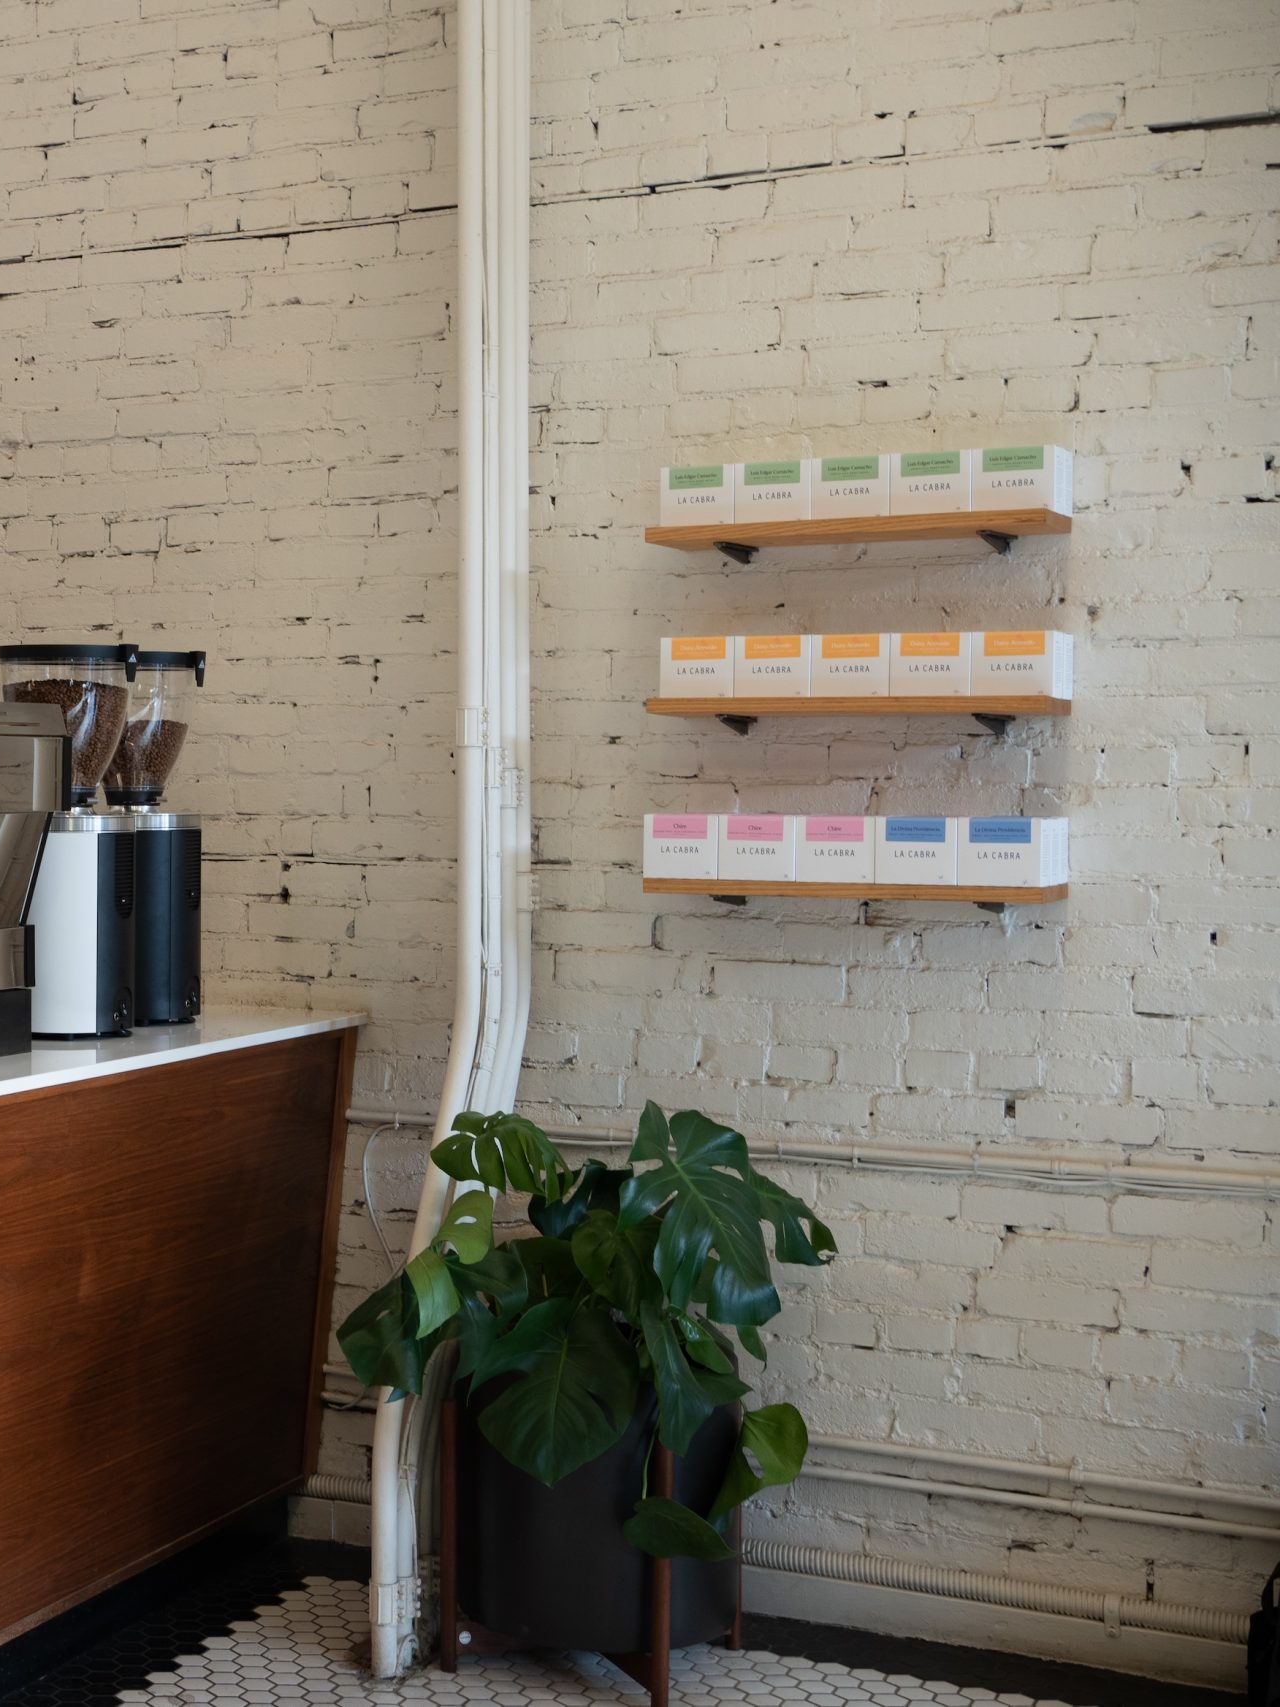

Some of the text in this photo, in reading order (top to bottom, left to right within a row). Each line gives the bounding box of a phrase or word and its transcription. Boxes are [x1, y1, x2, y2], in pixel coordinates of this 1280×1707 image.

[909, 482, 950, 492] LA CABRA
[992, 478, 1034, 488] LA CABRA
[766, 491, 792, 500] CABRA
[843, 487, 870, 496] CABRA
